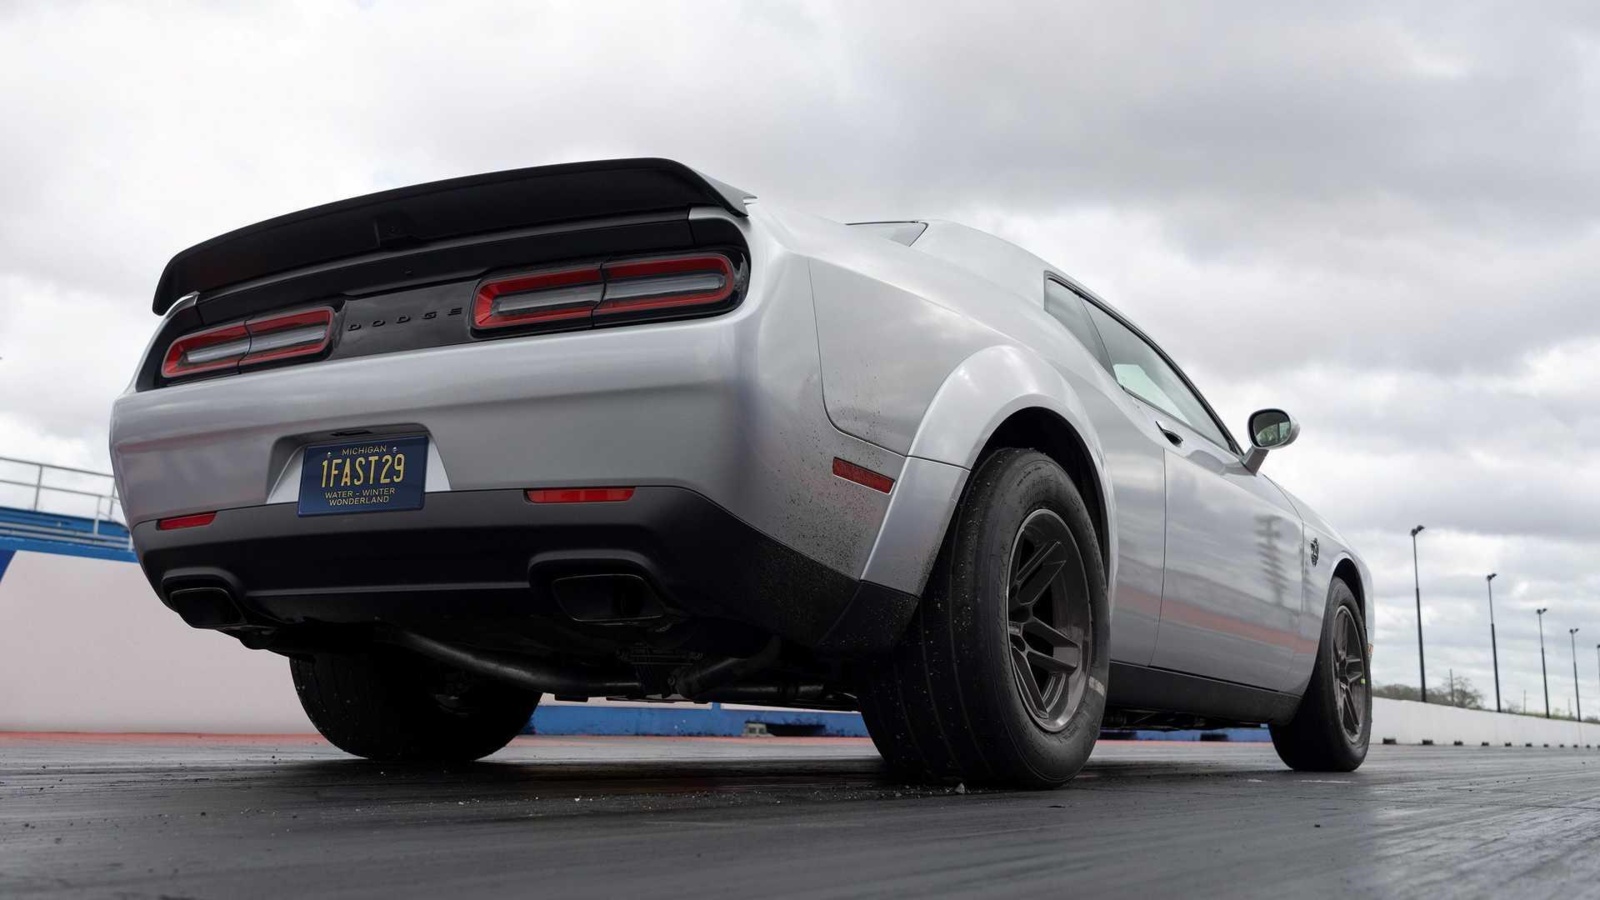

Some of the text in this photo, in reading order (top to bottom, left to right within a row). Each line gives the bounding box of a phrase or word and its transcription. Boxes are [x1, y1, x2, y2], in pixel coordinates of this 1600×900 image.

[347, 307, 463, 332] DODGE
[342, 445, 387, 456] MICHIGAN
[321, 453, 405, 488] 1FAST29
[325, 490, 353, 499] WATER
[362, 487, 395, 495] WINTER
[329, 496, 390, 506] WONDERLAND
